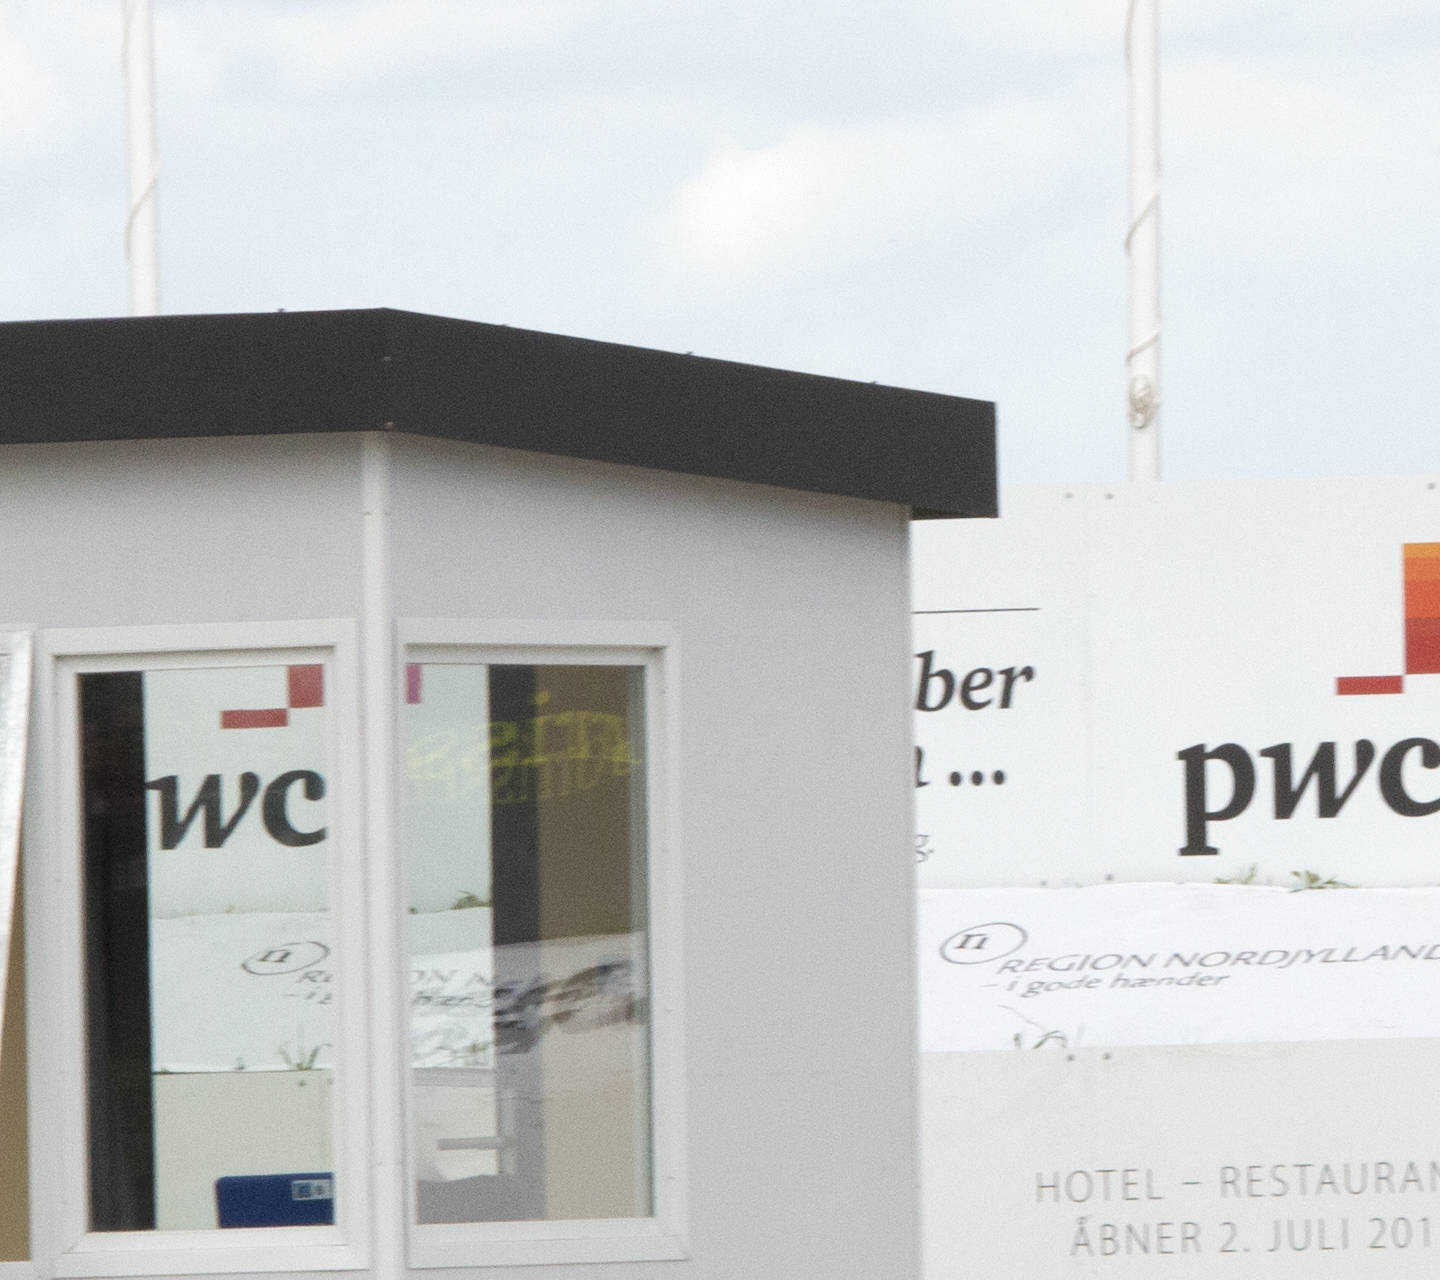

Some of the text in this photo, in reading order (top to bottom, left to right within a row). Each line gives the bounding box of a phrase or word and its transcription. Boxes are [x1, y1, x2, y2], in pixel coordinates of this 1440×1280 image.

[996, 951, 1157, 975] REGION
[1019, 972, 1103, 998] gode
[1111, 970, 1231, 990] hænder
[1034, 1168, 1166, 1205] HOTEL
[1069, 1214, 1203, 1258] ÅBNER
[1218, 1221, 1252, 1255] 2.
[1267, 1217, 1351, 1254] JULI
